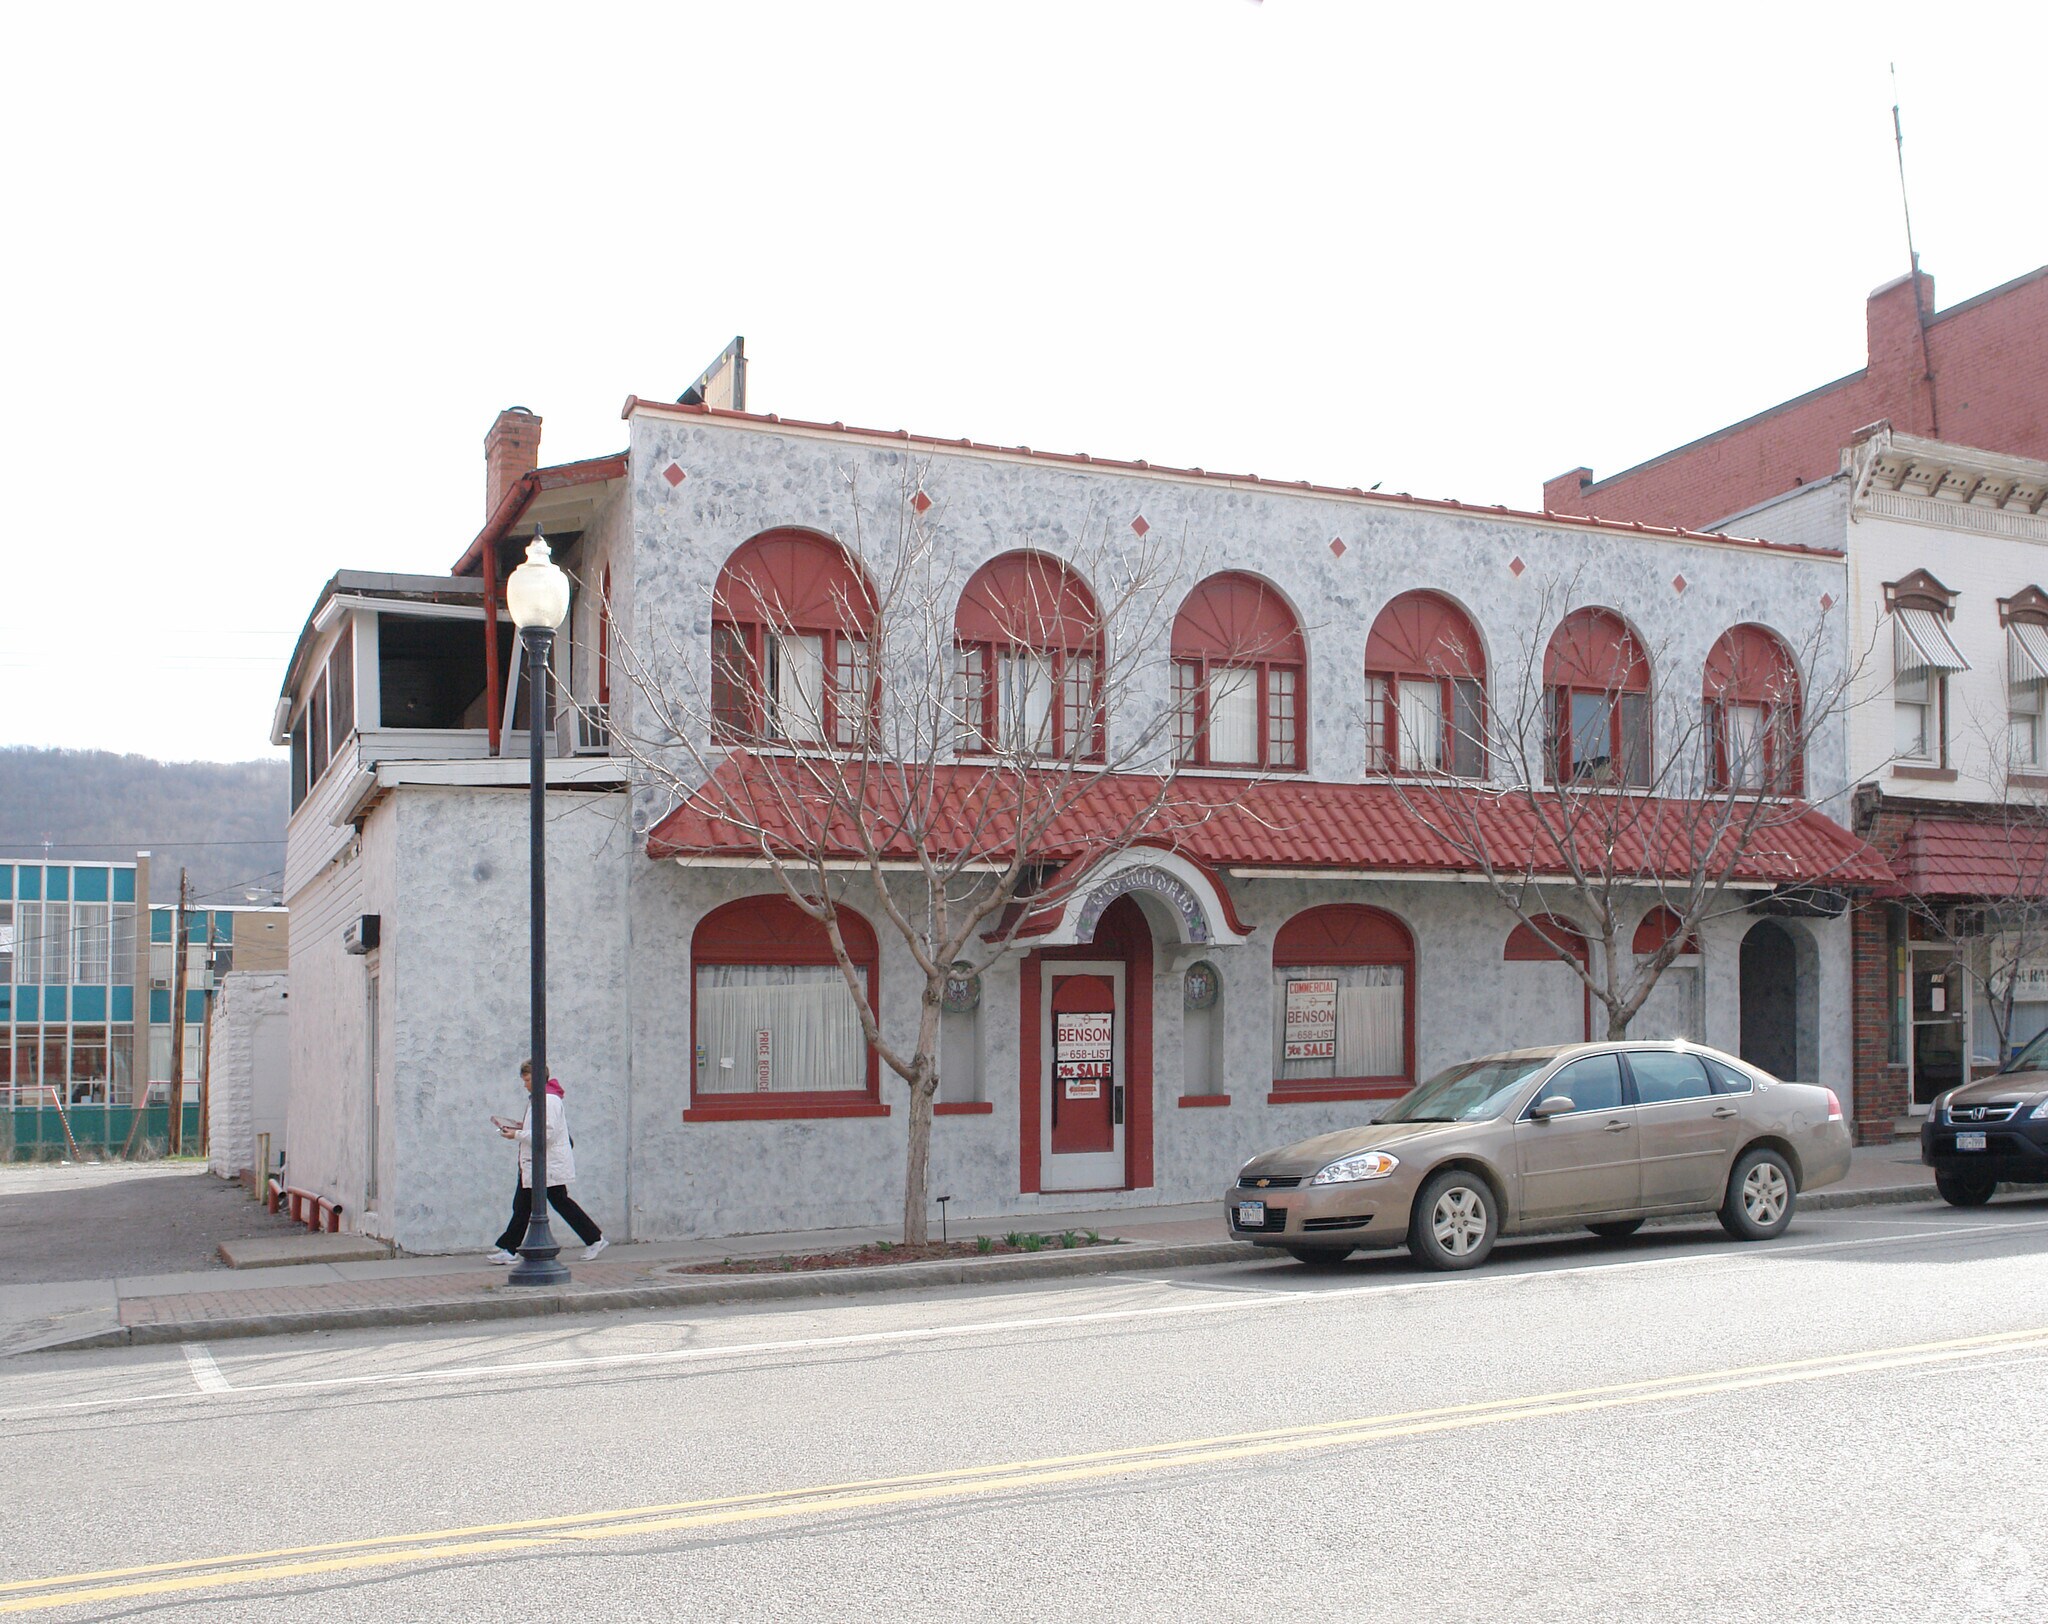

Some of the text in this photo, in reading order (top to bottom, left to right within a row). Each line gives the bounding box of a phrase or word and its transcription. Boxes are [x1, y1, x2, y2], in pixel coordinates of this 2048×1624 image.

[1290, 982, 1334, 994] COMMERCIAL
[1287, 1010, 1335, 1023] BENSON
[1059, 1028, 1111, 1042] BENSON
[1297, 1029, 1334, 1039] 658-LIST
[1069, 1049, 1110, 1059] 658-LIST
[1303, 1043, 1333, 1056] SALE
[759, 1031, 770, 1093] PRICE REDUCE
[1076, 1063, 1110, 1077] SALE
